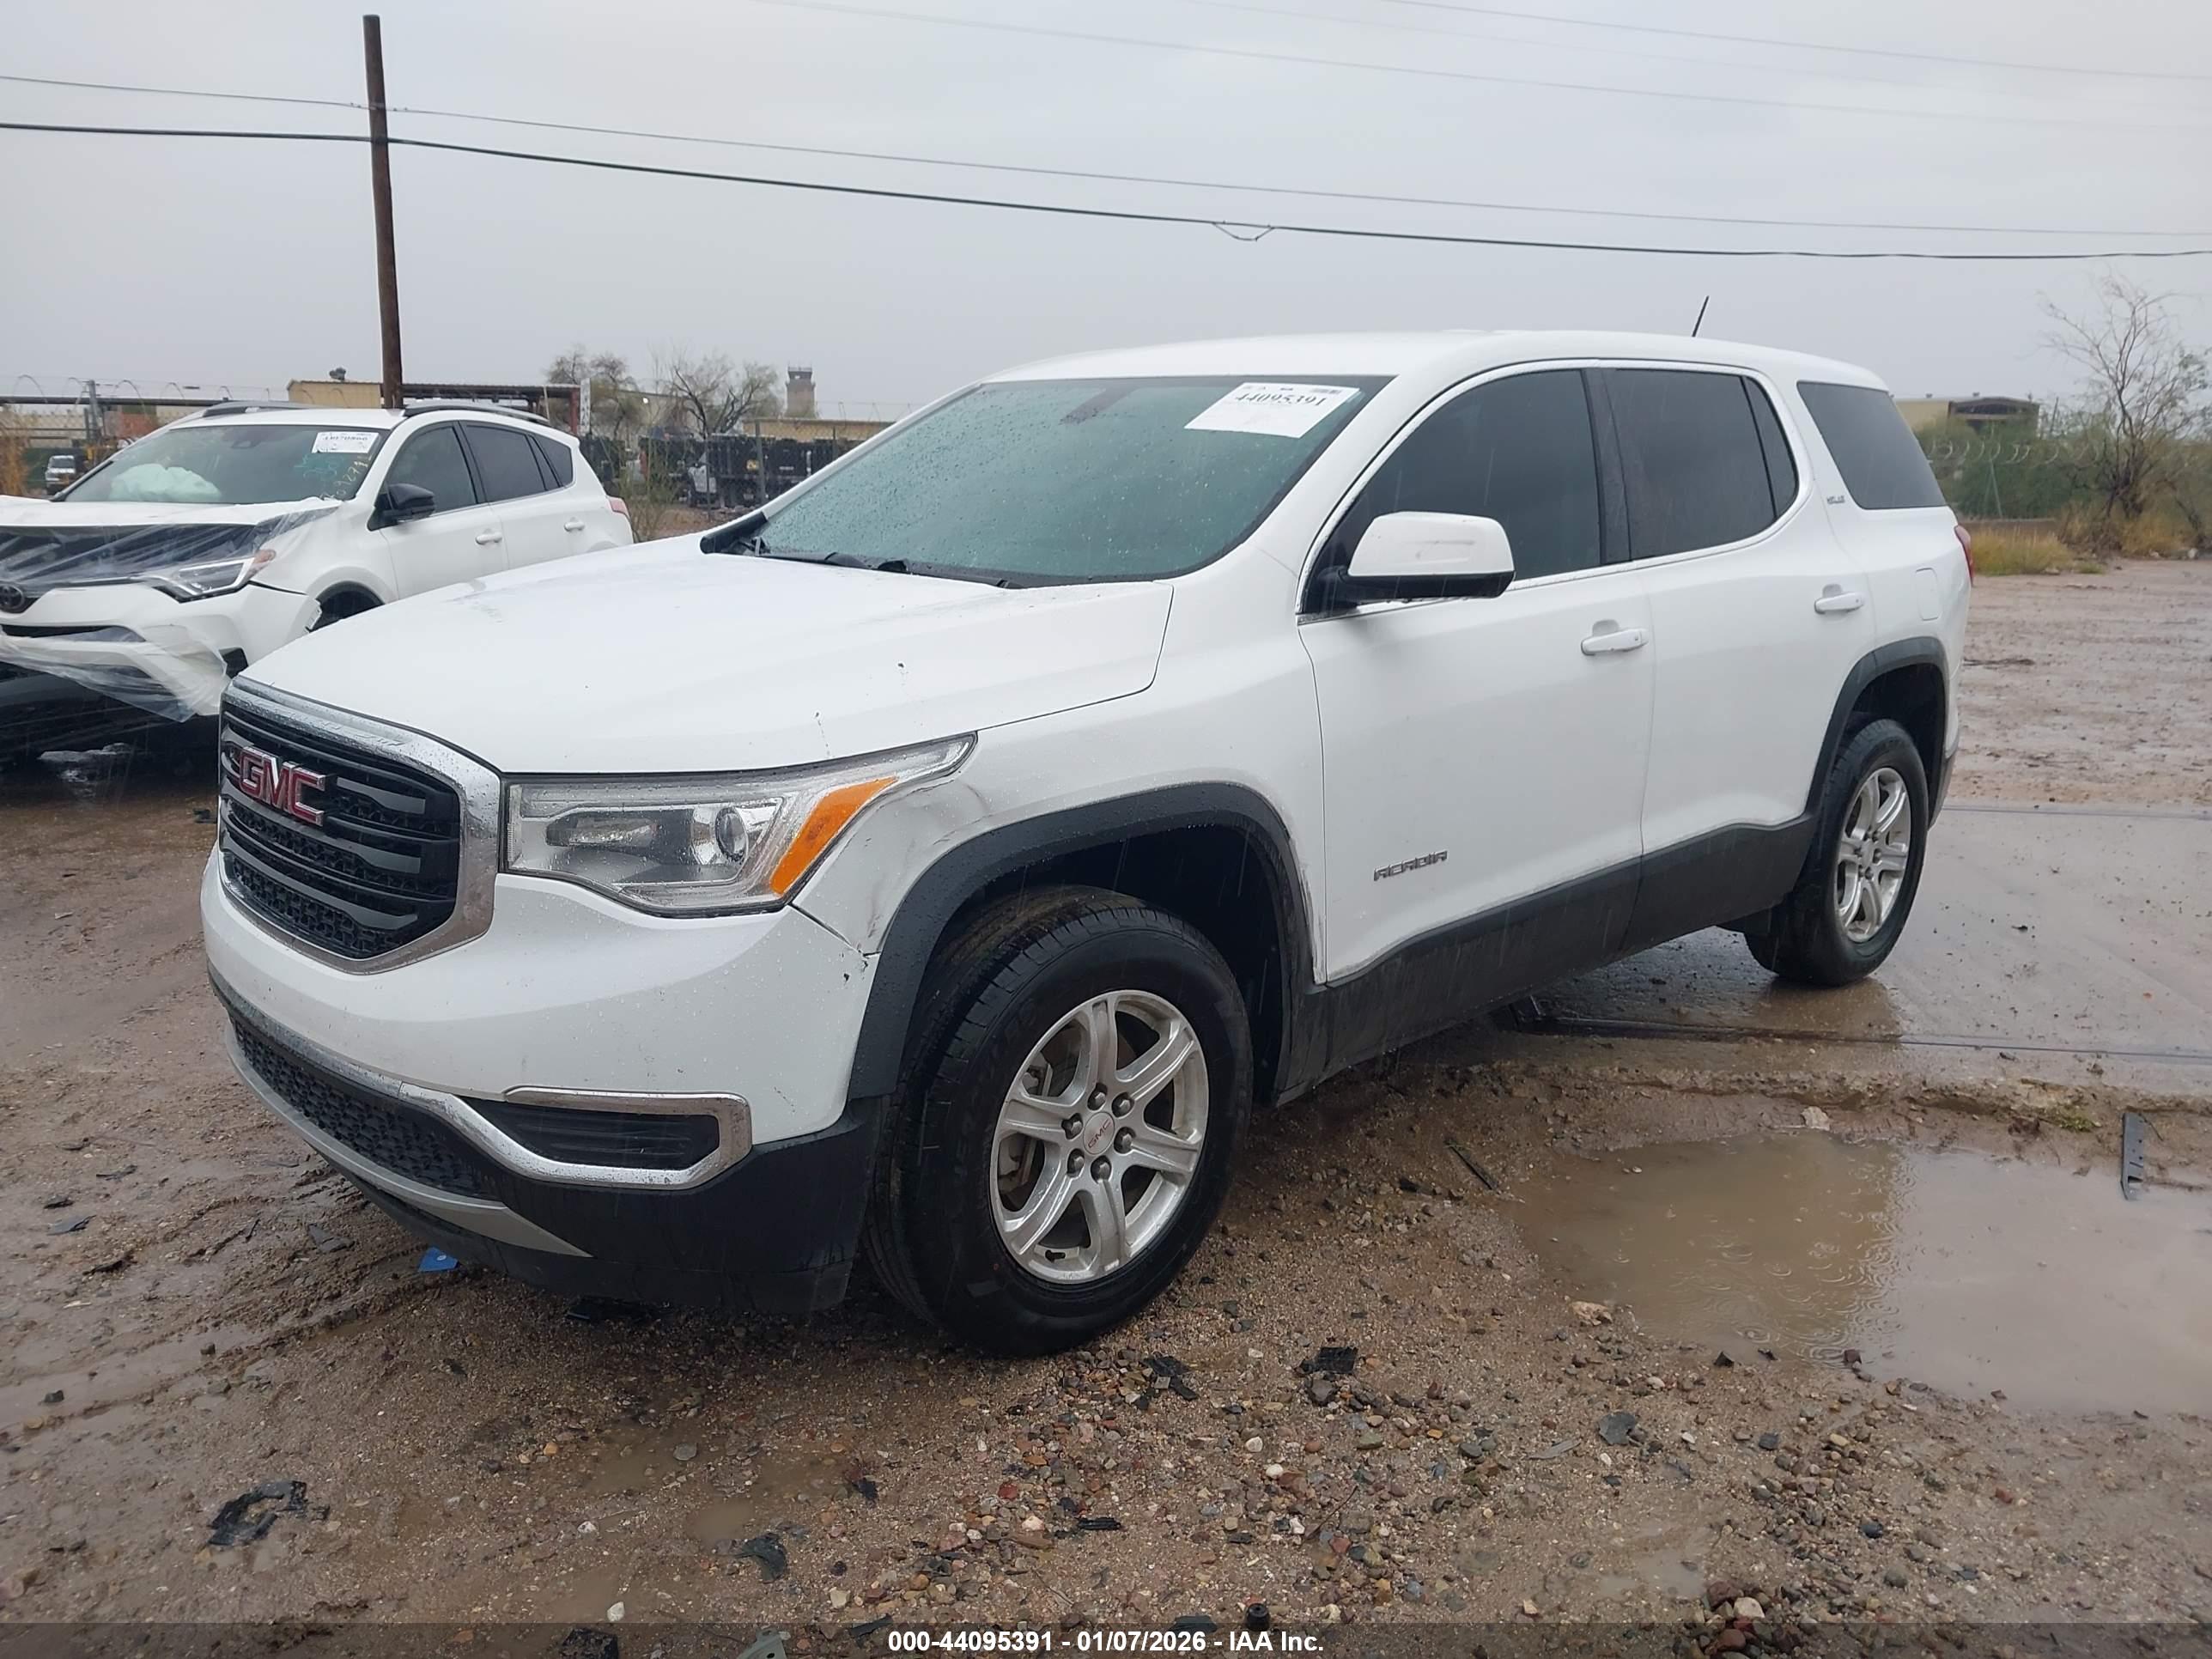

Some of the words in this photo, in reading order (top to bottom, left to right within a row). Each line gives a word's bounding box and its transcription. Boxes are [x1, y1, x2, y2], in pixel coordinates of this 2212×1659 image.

[239, 746, 327, 827] GMC
[1373, 849, 1449, 881] ACADIA
[1088, 1118, 1112, 1148] GMC
